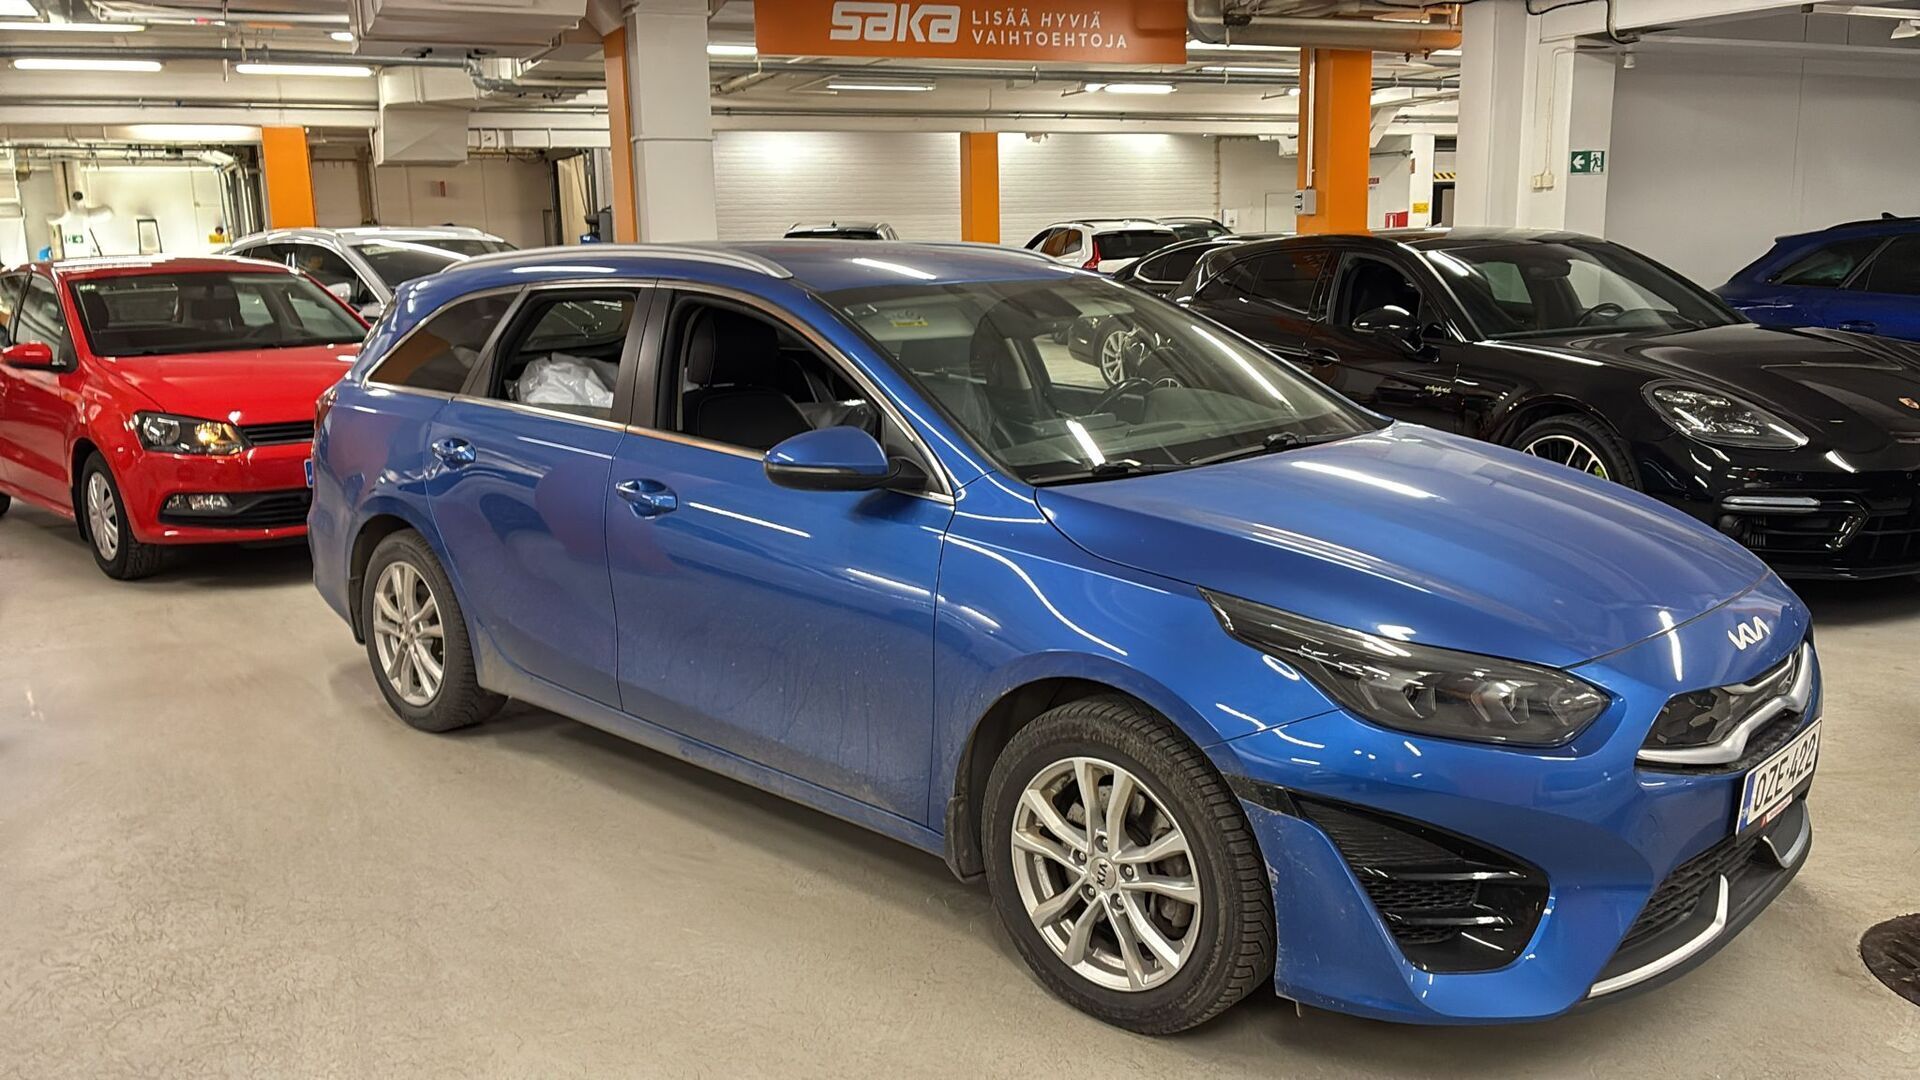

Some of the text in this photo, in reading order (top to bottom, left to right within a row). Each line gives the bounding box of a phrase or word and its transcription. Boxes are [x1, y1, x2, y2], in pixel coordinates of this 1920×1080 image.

[972, 8, 1101, 29] LISÄÄ HYVIÄ
[972, 29, 1127, 49] VAIHTOEHTOJA
[1753, 732, 1817, 812] OZE-422
[1097, 863, 1108, 887] KIA
